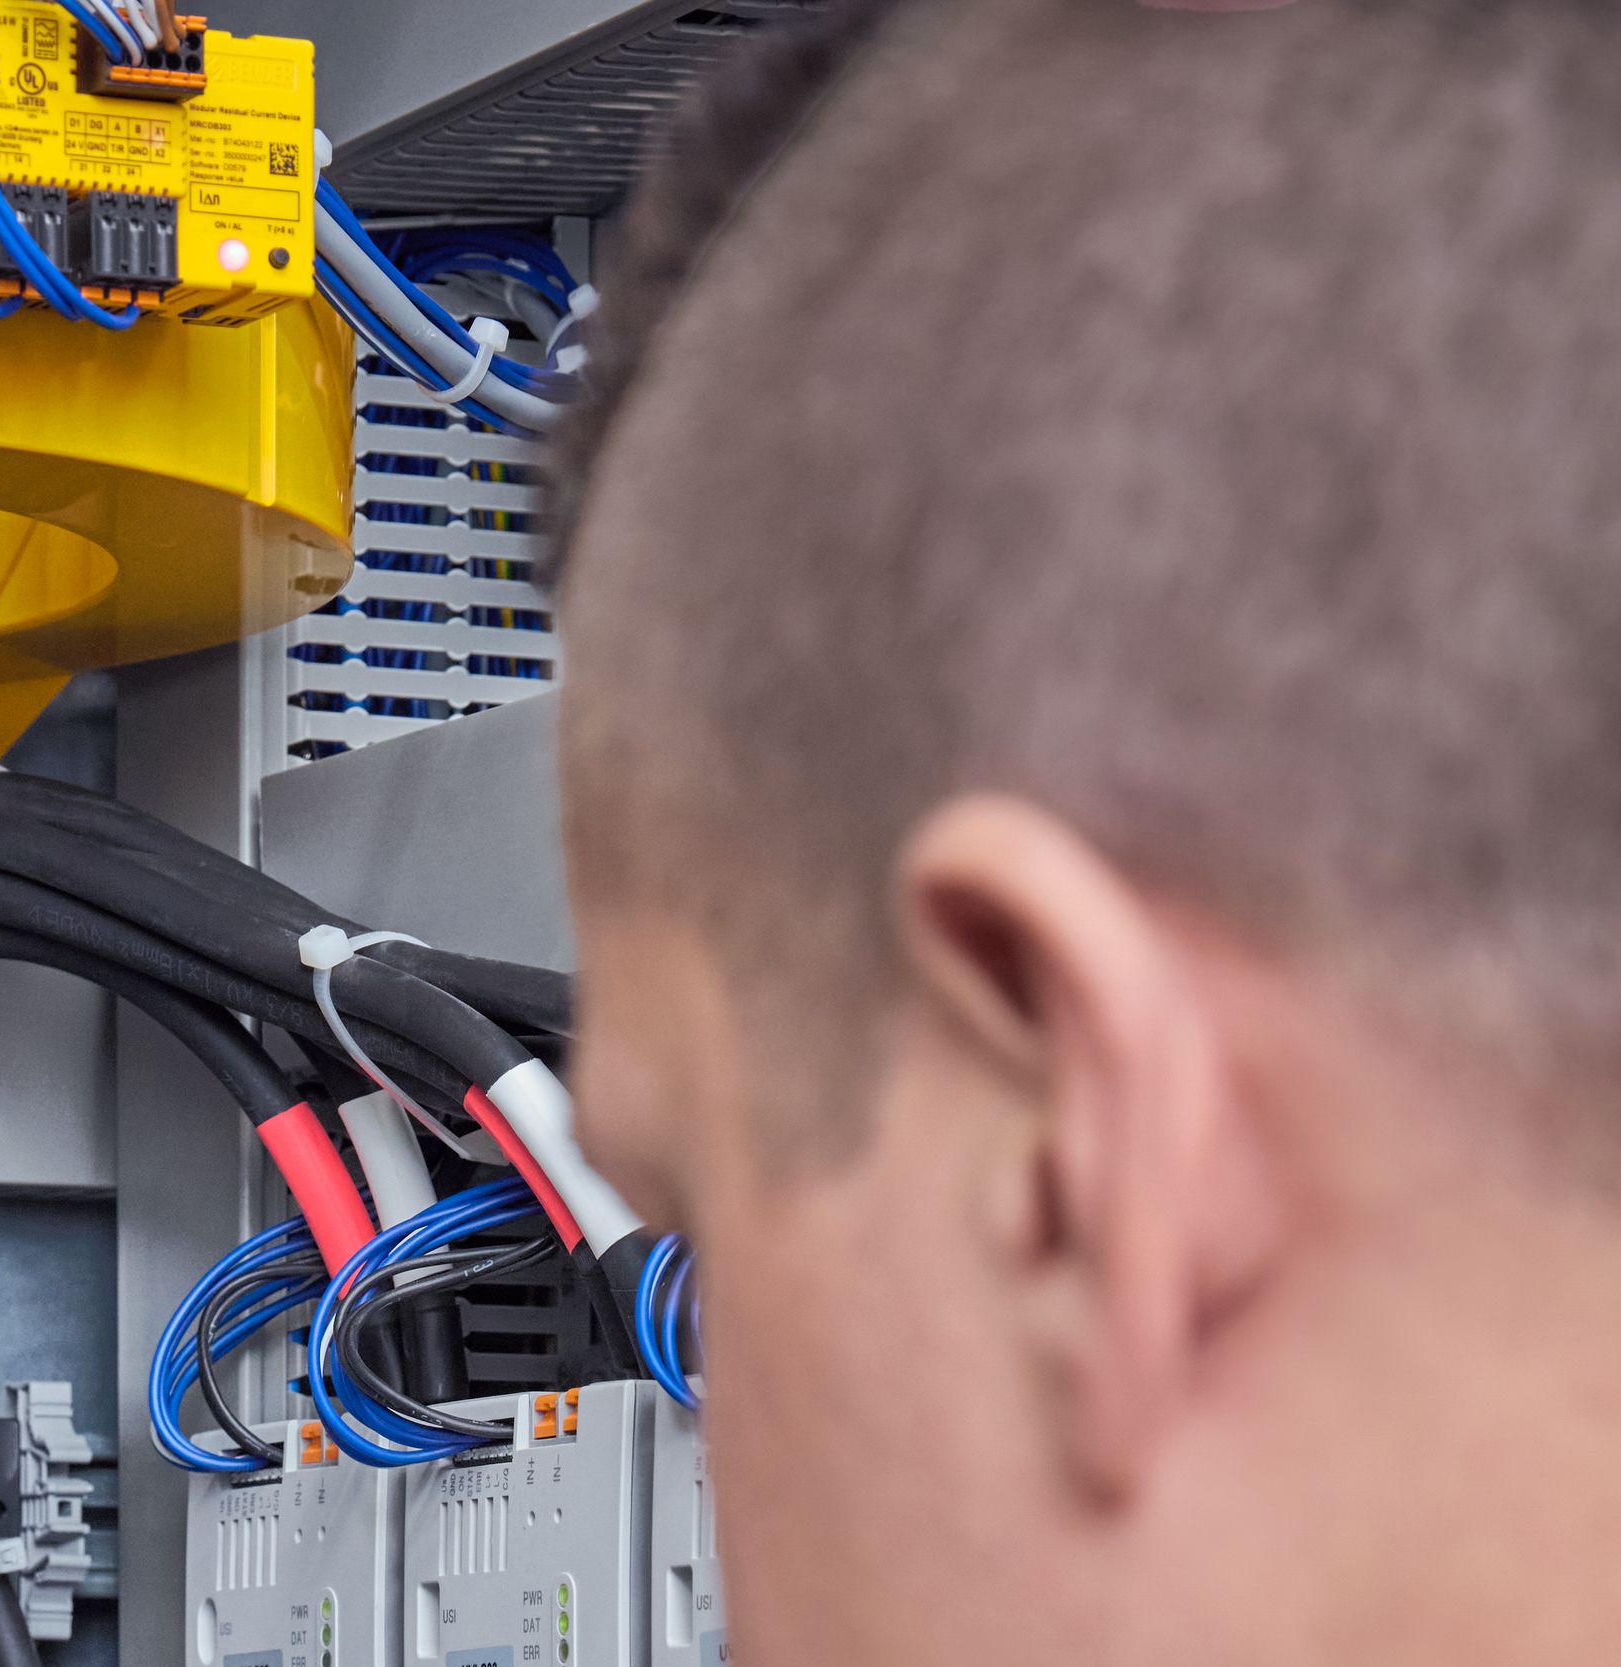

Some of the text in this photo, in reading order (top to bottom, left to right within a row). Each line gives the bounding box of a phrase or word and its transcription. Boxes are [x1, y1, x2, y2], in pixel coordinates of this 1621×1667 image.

[114, 122, 121, 131] A
[135, 124, 141, 133] B
[87, 141, 106, 151] GND
[130, 145, 148, 156] GND
[524, 1591, 542, 1605] PWR
[697, 1596, 712, 1610] USI
[292, 1606, 308, 1620] PWR
[443, 1609, 456, 1623] USI
[524, 1618, 540, 1633] DAT
[292, 1631, 306, 1645] DAT
[524, 1645, 540, 1660] ERR
